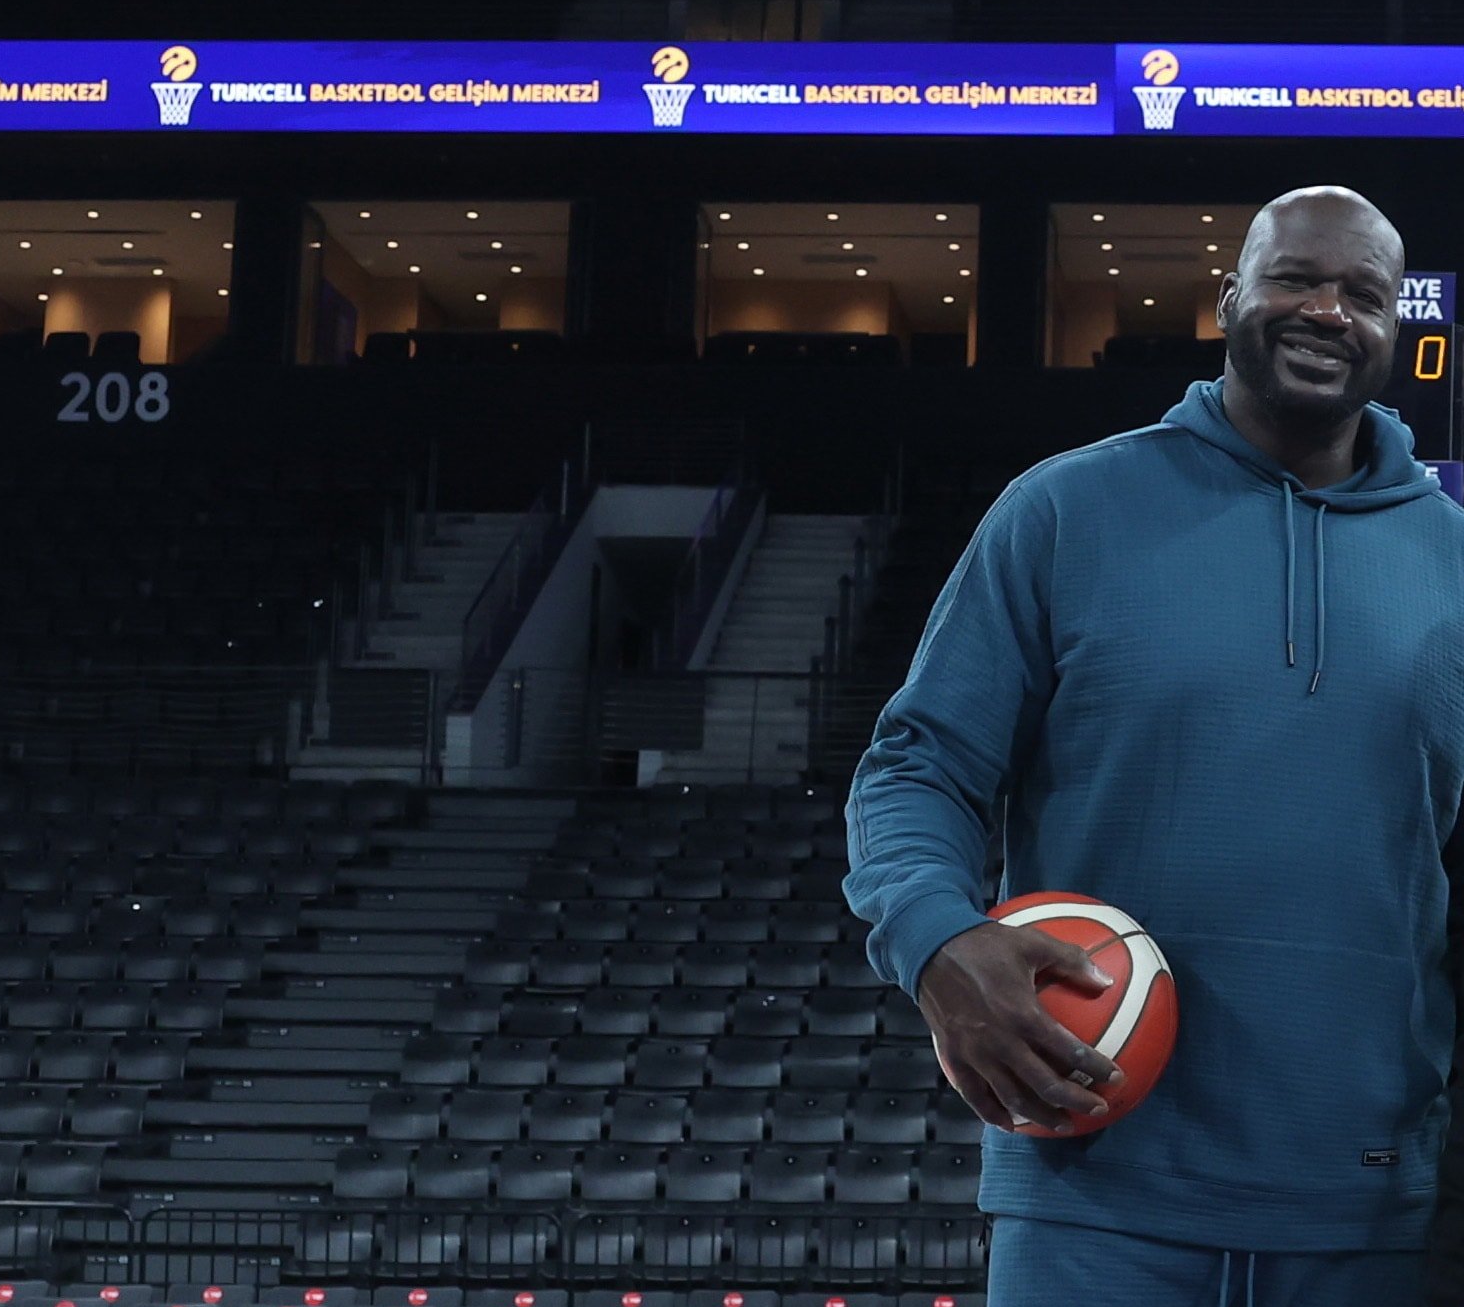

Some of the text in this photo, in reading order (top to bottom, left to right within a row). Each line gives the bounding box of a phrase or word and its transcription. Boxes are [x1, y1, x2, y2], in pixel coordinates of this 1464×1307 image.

[21, 78, 108, 102] MERKEZİ
[209, 79, 600, 107] TURKCELL BASKETBOL GELİŞİM MERKEZİ
[702, 81, 1098, 109] TURKCELL BASKETBOL GELİŞİM MERKEZİ
[1193, 86, 1293, 107] TURKCELL
[1295, 87, 1414, 108] BASKETBOL
[1415, 335, 1446, 380] 0
[57, 371, 170, 422] 208
